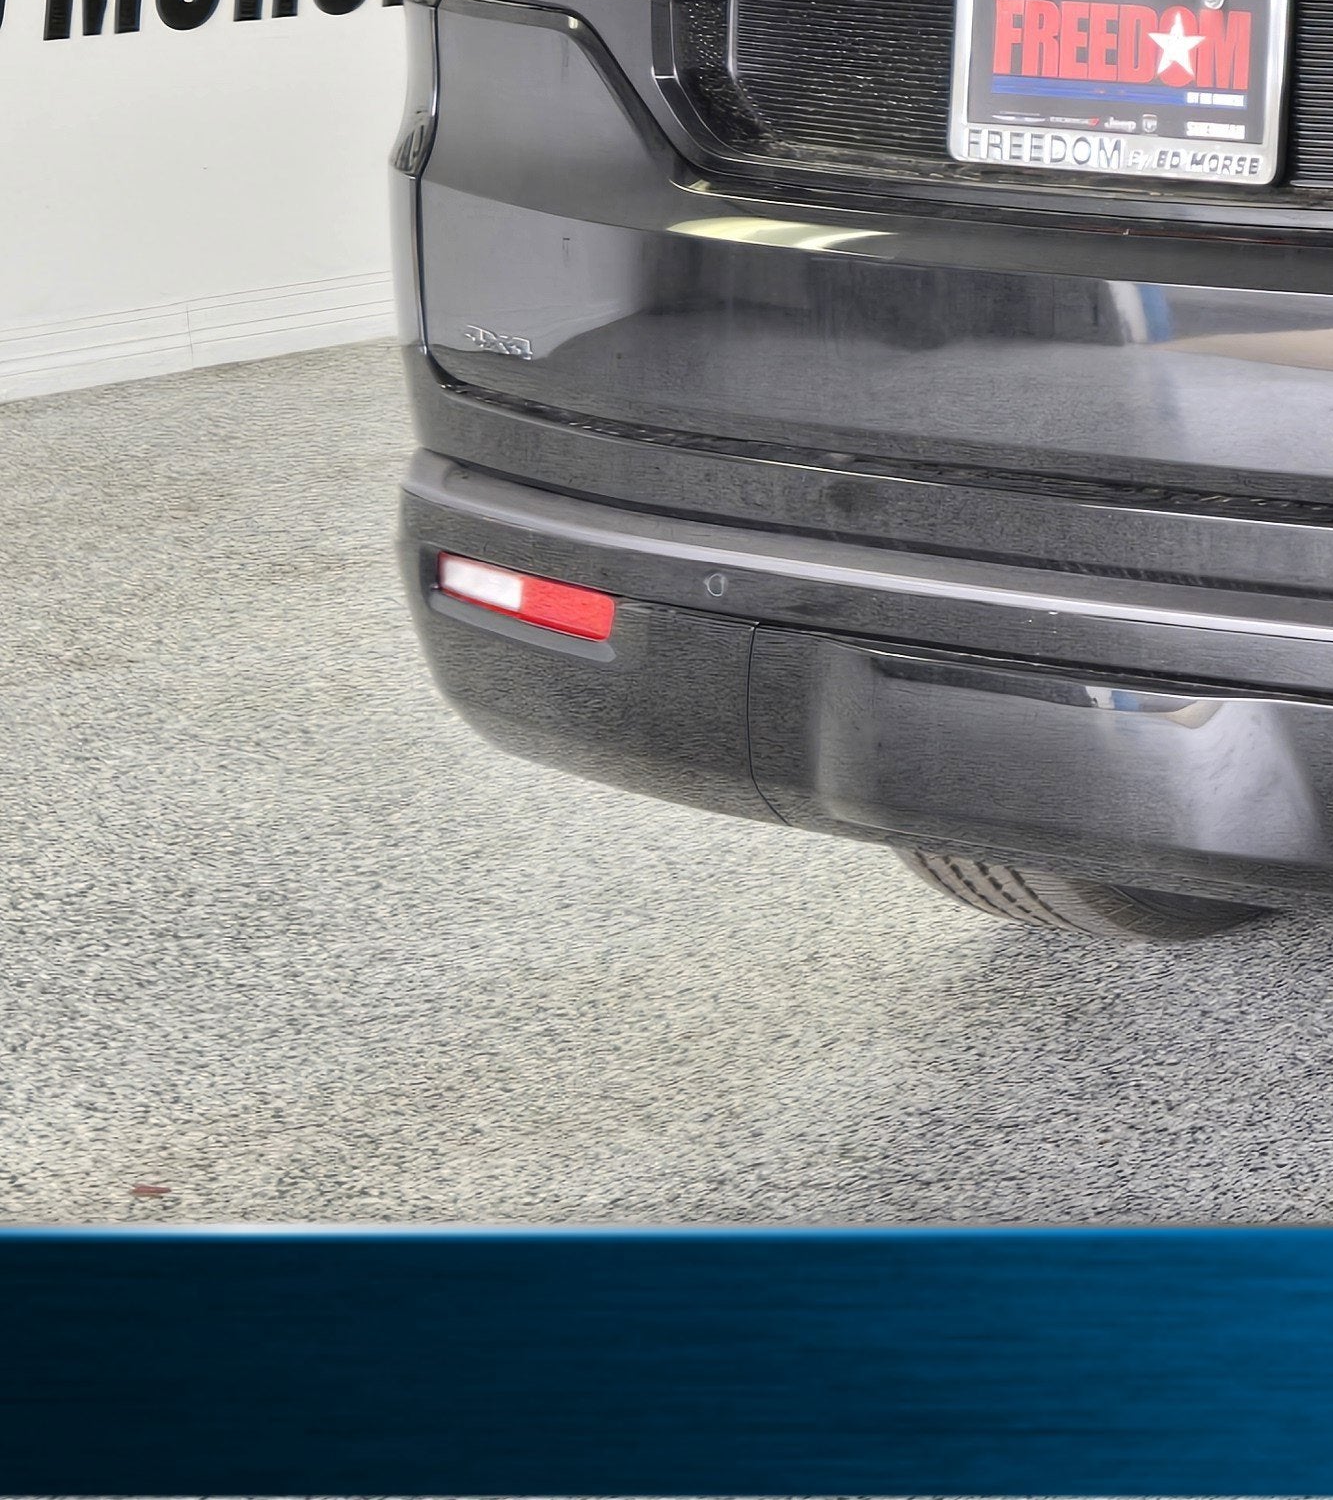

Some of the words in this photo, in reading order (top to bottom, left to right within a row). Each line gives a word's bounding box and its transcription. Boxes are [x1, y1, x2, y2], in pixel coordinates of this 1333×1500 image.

[966, 128, 1126, 171] FREEDOM
[1156, 149, 1181, 169] ED
[1189, 152, 1262, 176] MORSE
